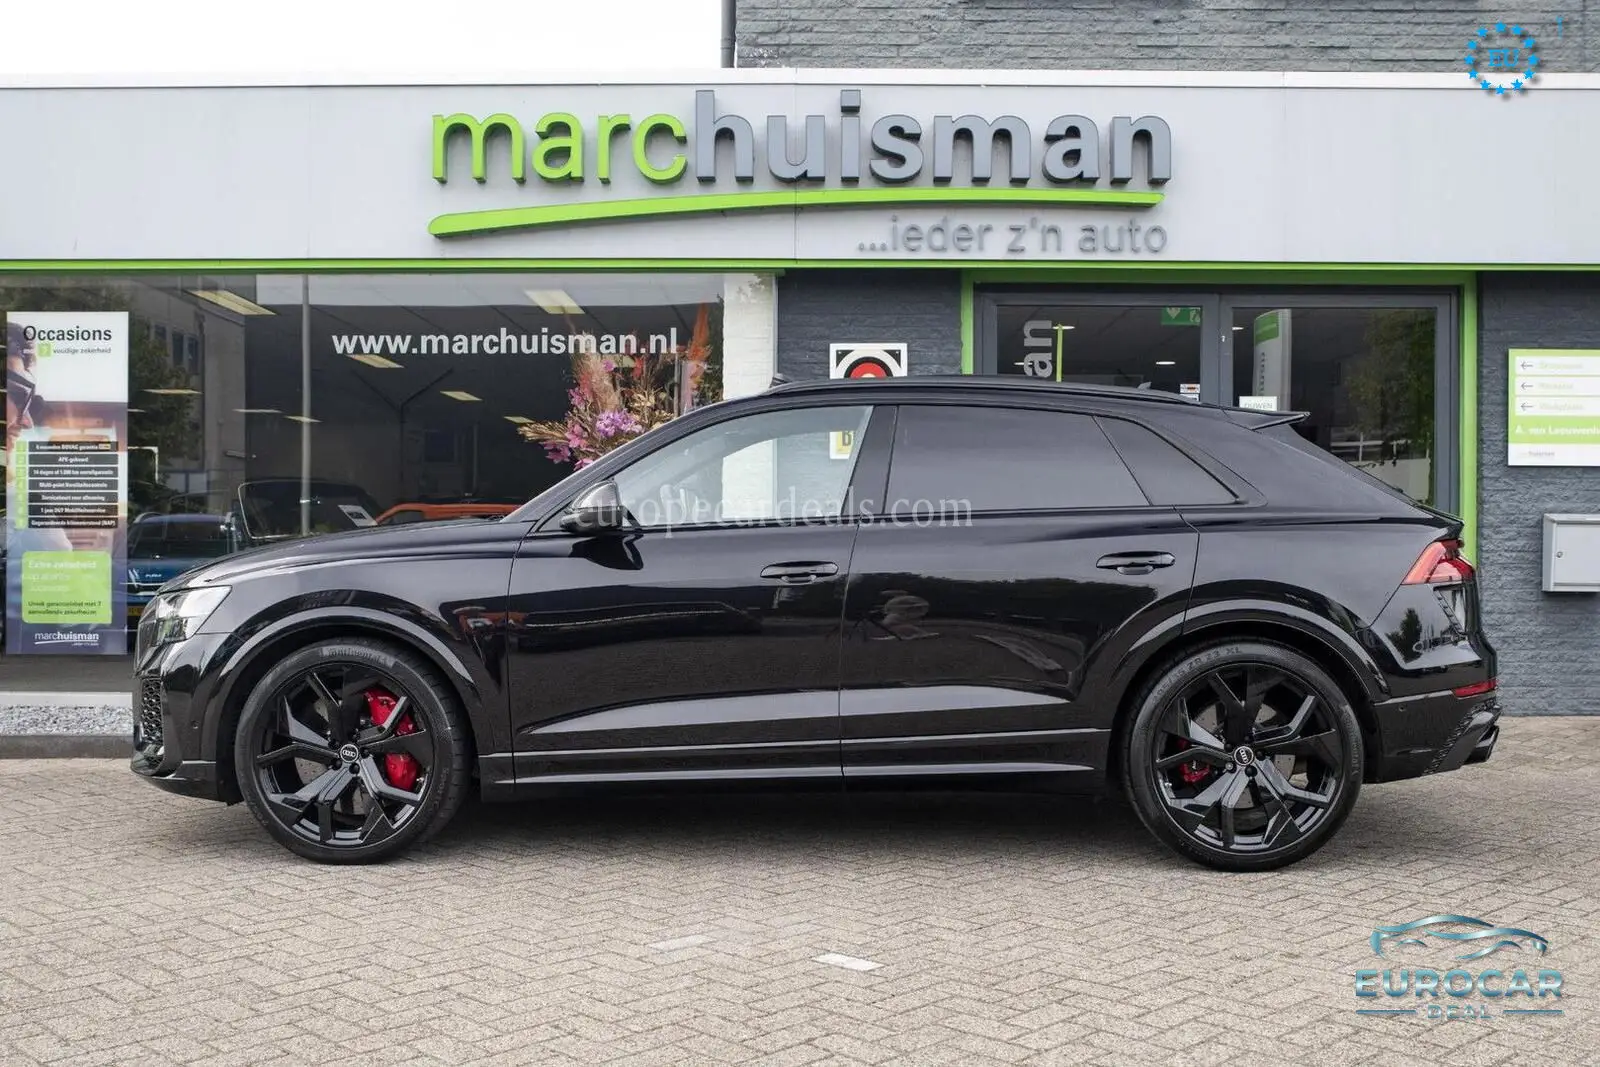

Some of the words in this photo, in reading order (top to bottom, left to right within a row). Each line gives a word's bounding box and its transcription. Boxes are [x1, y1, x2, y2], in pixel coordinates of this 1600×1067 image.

[432, 88, 1172, 185] marchuisman
[1008, 217, 1062, 252] z'n
[1078, 218, 1168, 252] auto
[23, 325, 112, 341] Occasions
[332, 327, 678, 354] www.marchuisman.nl
[34, 631, 99, 640] marchuisman
